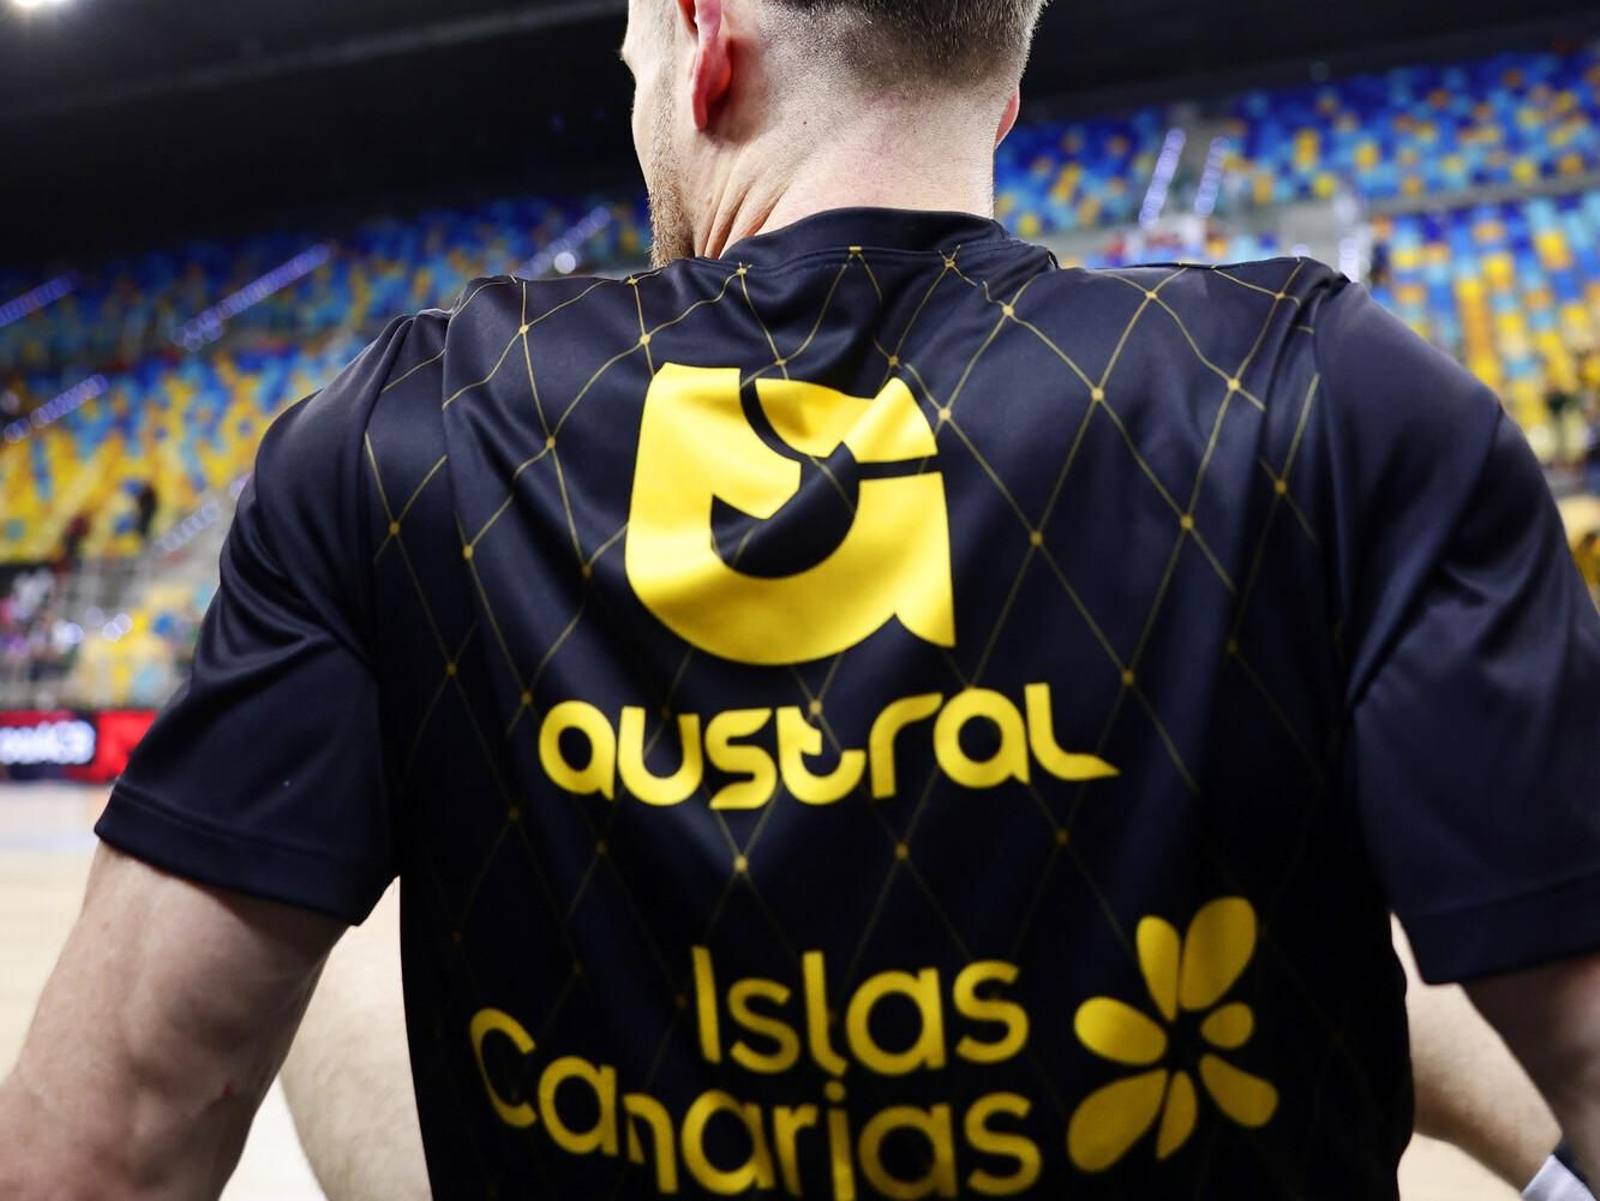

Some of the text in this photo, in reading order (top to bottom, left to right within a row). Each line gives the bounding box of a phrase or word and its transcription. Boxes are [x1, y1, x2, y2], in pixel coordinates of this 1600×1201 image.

[538, 681, 1121, 811] austral
[691, 945, 1030, 1077] Islas
[469, 1008, 1042, 1201] Canarias
